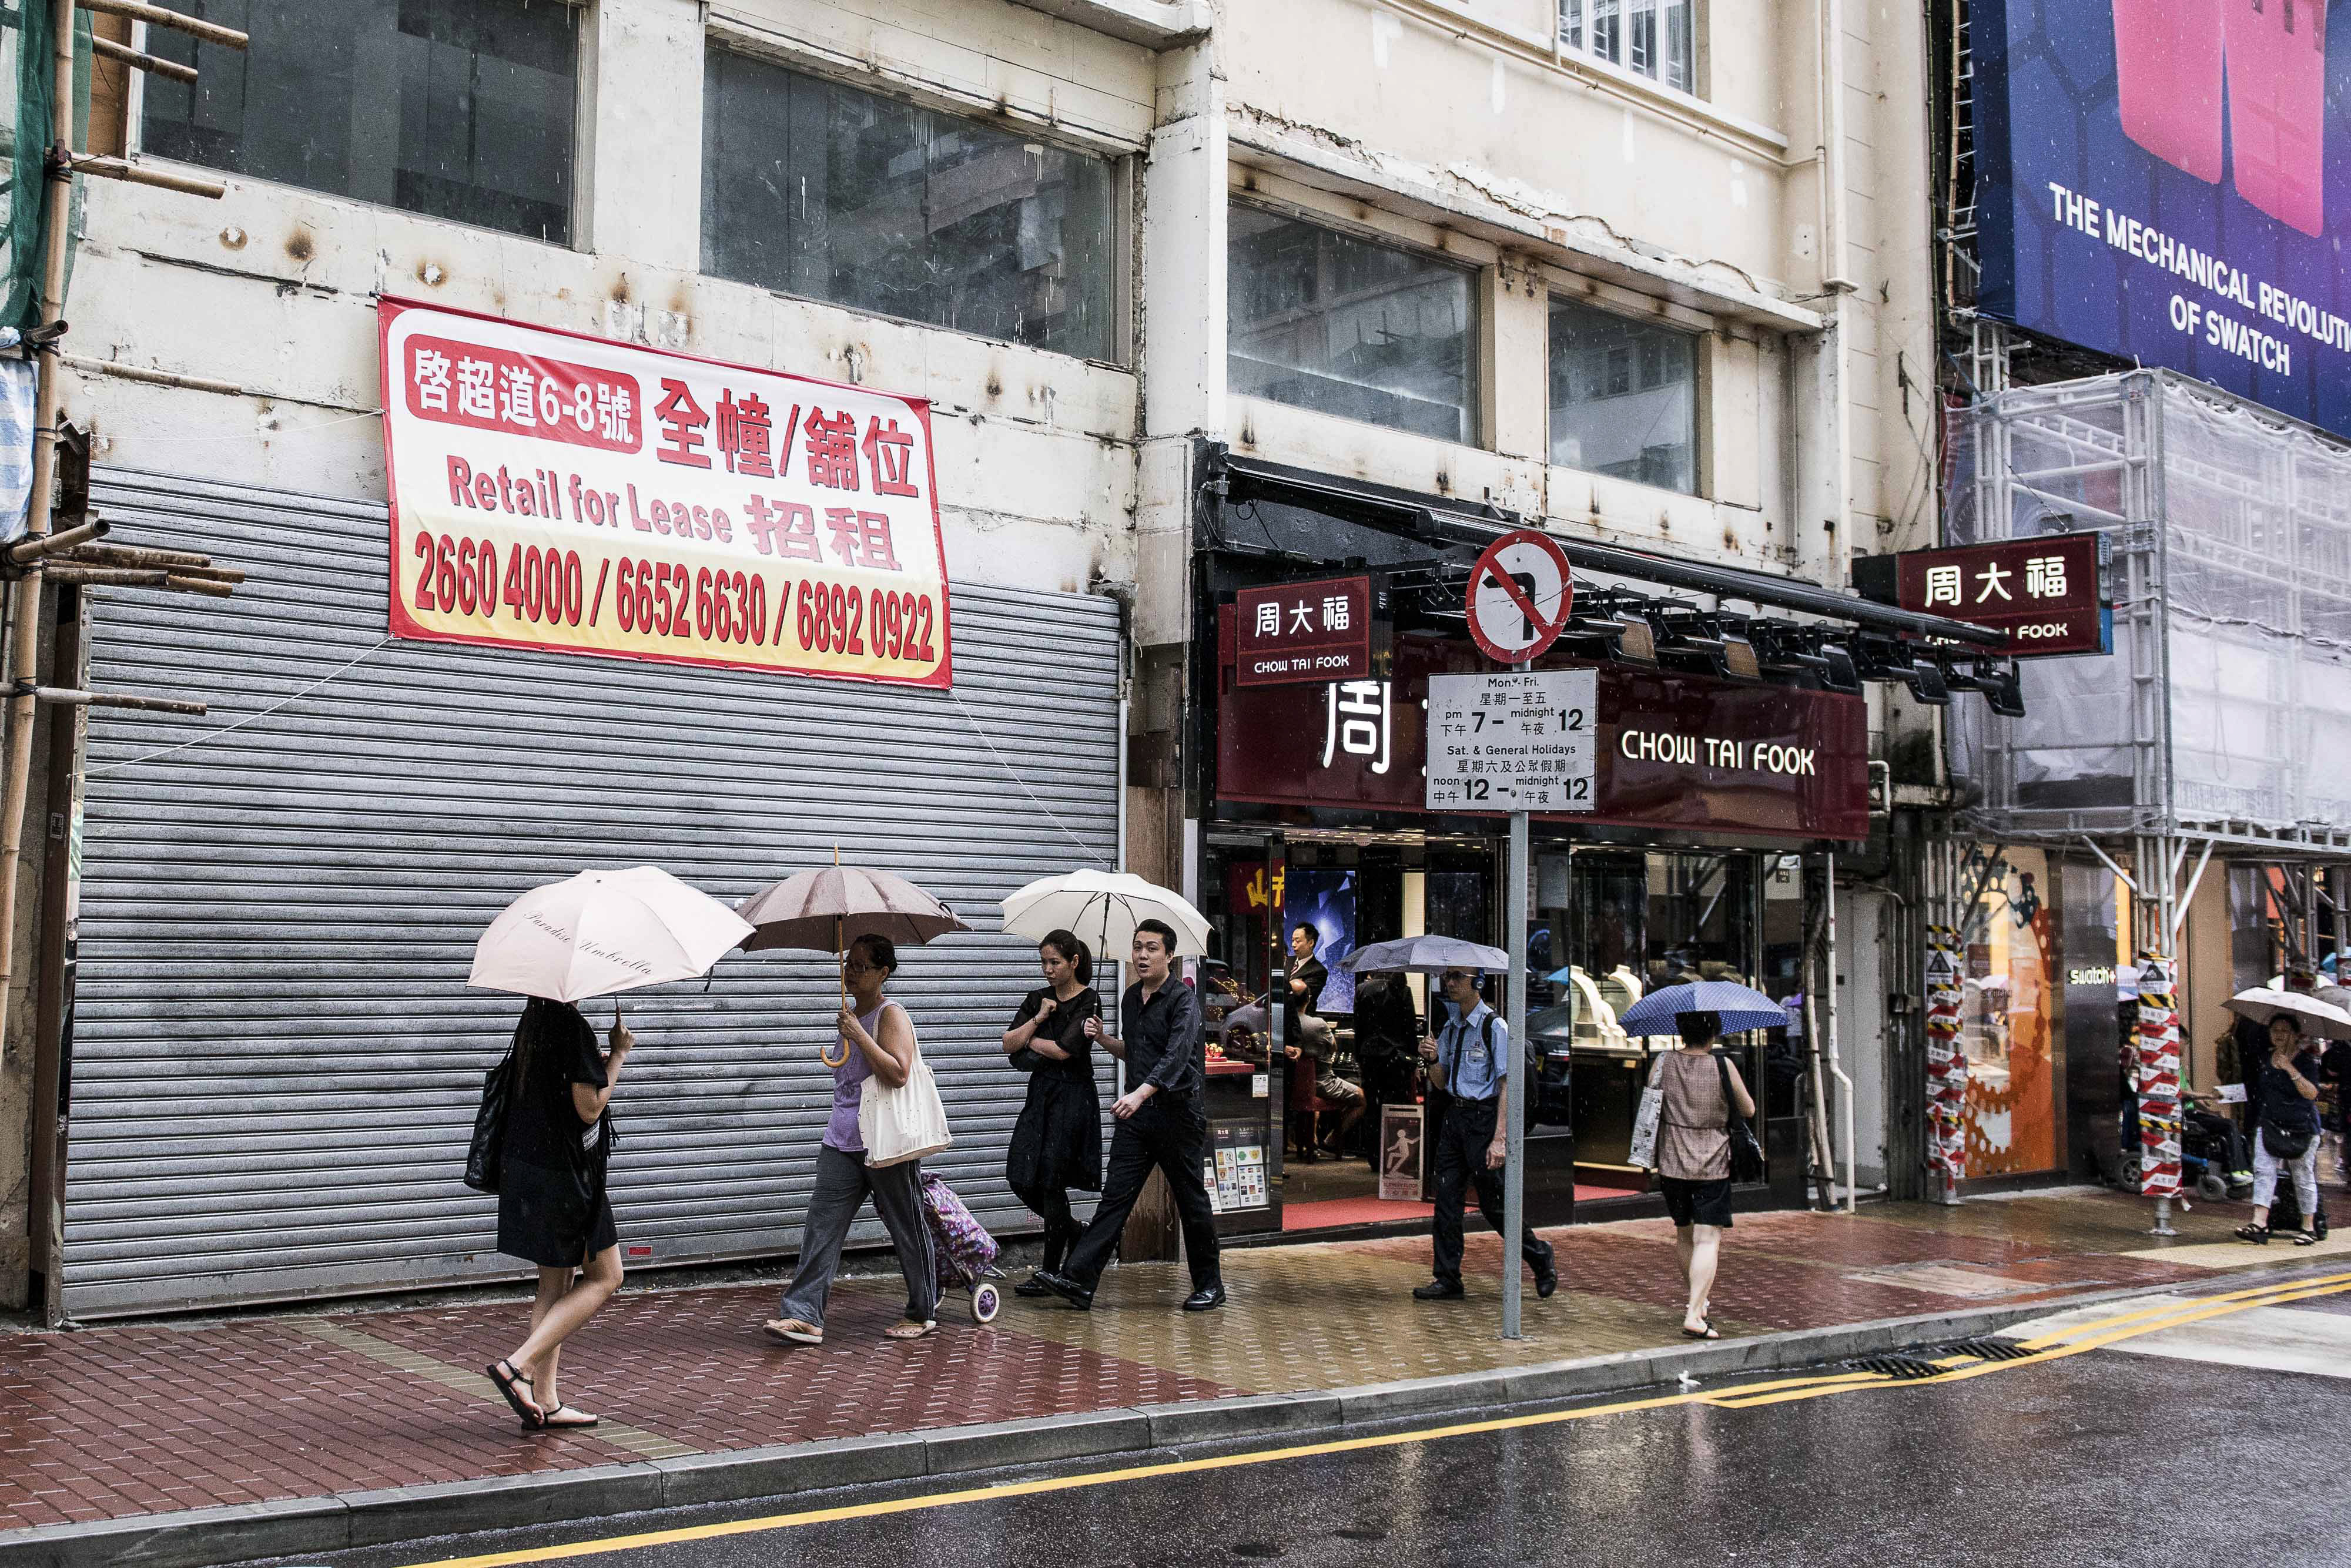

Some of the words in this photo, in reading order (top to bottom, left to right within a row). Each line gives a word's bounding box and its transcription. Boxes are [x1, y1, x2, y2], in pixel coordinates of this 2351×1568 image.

[2049, 182, 2100, 239] THE
[2106, 209, 2255, 310] MECHANICAL
[2259, 282, 2351, 353] REVOLUTI
[2169, 294, 2201, 335] OF
[2205, 310, 2290, 376] SWATCH
[446, 455, 562, 520] Retail
[569, 473, 619, 527] for
[627, 483, 733, 544] Lease
[744, 494, 903, 572] 招租
[1924, 555, 2067, 608] 周大福
[414, 531, 497, 619] 2660
[503, 542, 582, 628] 4000
[615, 556, 691, 638] 6652
[695, 569, 766, 646] 6630
[796, 579, 864, 656] 6892
[870, 590, 935, 663] 0922
[1255, 595, 1349, 638] 周大福
[2017, 623, 2068, 639] FOOK
[1254, 660, 1288, 674] CHOW
[1291, 658, 1311, 671] TAI
[1316, 655, 1349, 669] FOOK
[1524, 677, 1539, 686] Fri.
[1479, 691, 1546, 706] 星期一至五
[1441, 724, 1467, 737] 下午
[1521, 722, 1545, 735] 午夜
[1445, 711, 1462, 720] pm
[1471, 712, 1486, 733] 7
[1511, 706, 1555, 718] midnight
[1558, 708, 1584, 731] 12
[1447, 745, 1469, 755] Sat.
[1473, 746, 1481, 755] &
[1486, 745, 1528, 755] General
[1532, 745, 1576, 756] Holidays
[1622, 730, 1696, 764] CHOW
[1704, 738, 1743, 769] TAI
[1754, 743, 1816, 776] FOOK
[1434, 777, 1460, 786] noon
[1464, 779, 1489, 800] 12
[1515, 776, 1559, 787] midnight
[1563, 778, 1589, 800] 12
[1434, 790, 1460, 804] 中午
[1525, 790, 1549, 804] 午夜
[522, 912, 571, 943] Paradise
[579, 939, 651, 974] Umbrella
